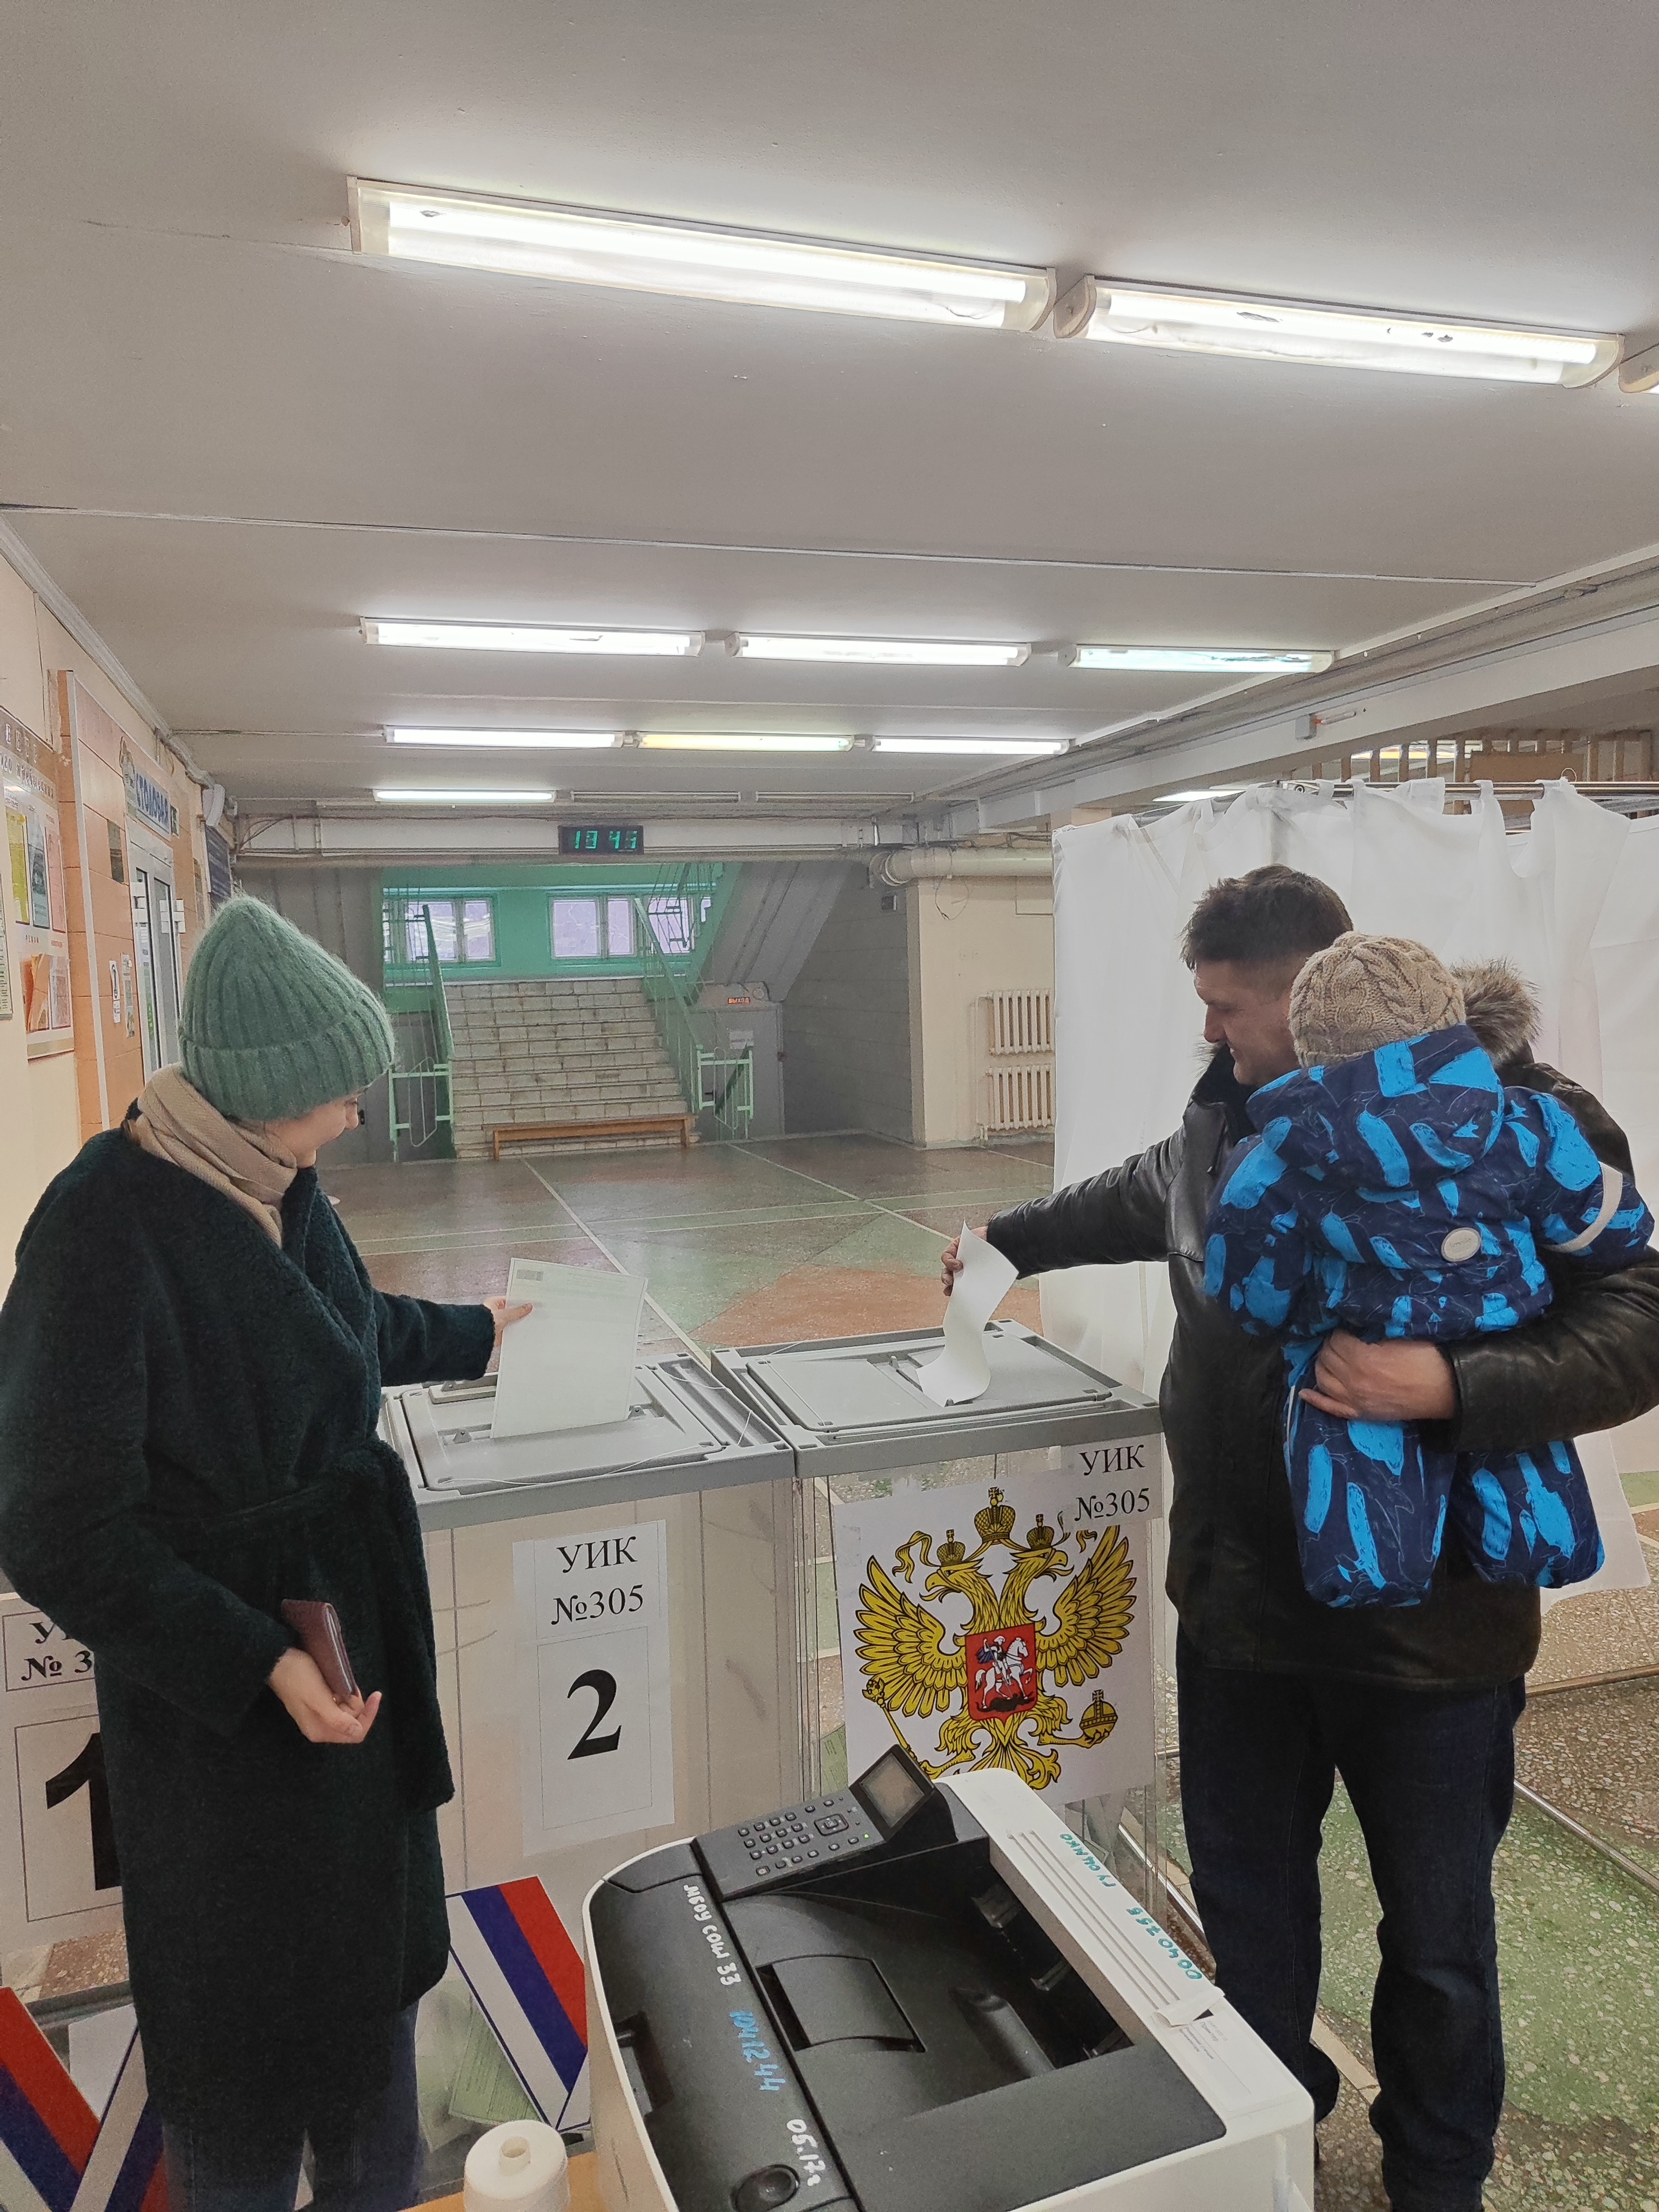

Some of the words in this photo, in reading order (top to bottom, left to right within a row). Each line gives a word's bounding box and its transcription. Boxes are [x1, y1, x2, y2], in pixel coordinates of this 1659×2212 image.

[1078, 1444, 1145, 1476] УИК
[1074, 1488, 1150, 1522] №305
[556, 1535, 638, 1574] УИК
[551, 1584, 644, 1625] №305
[567, 1669, 622, 1760] 2
[45, 1732, 122, 1890] 1
[683, 1884, 712, 1921] МБОУ
[702, 1925, 730, 1958] СОШ
[717, 1962, 741, 1985] 33
